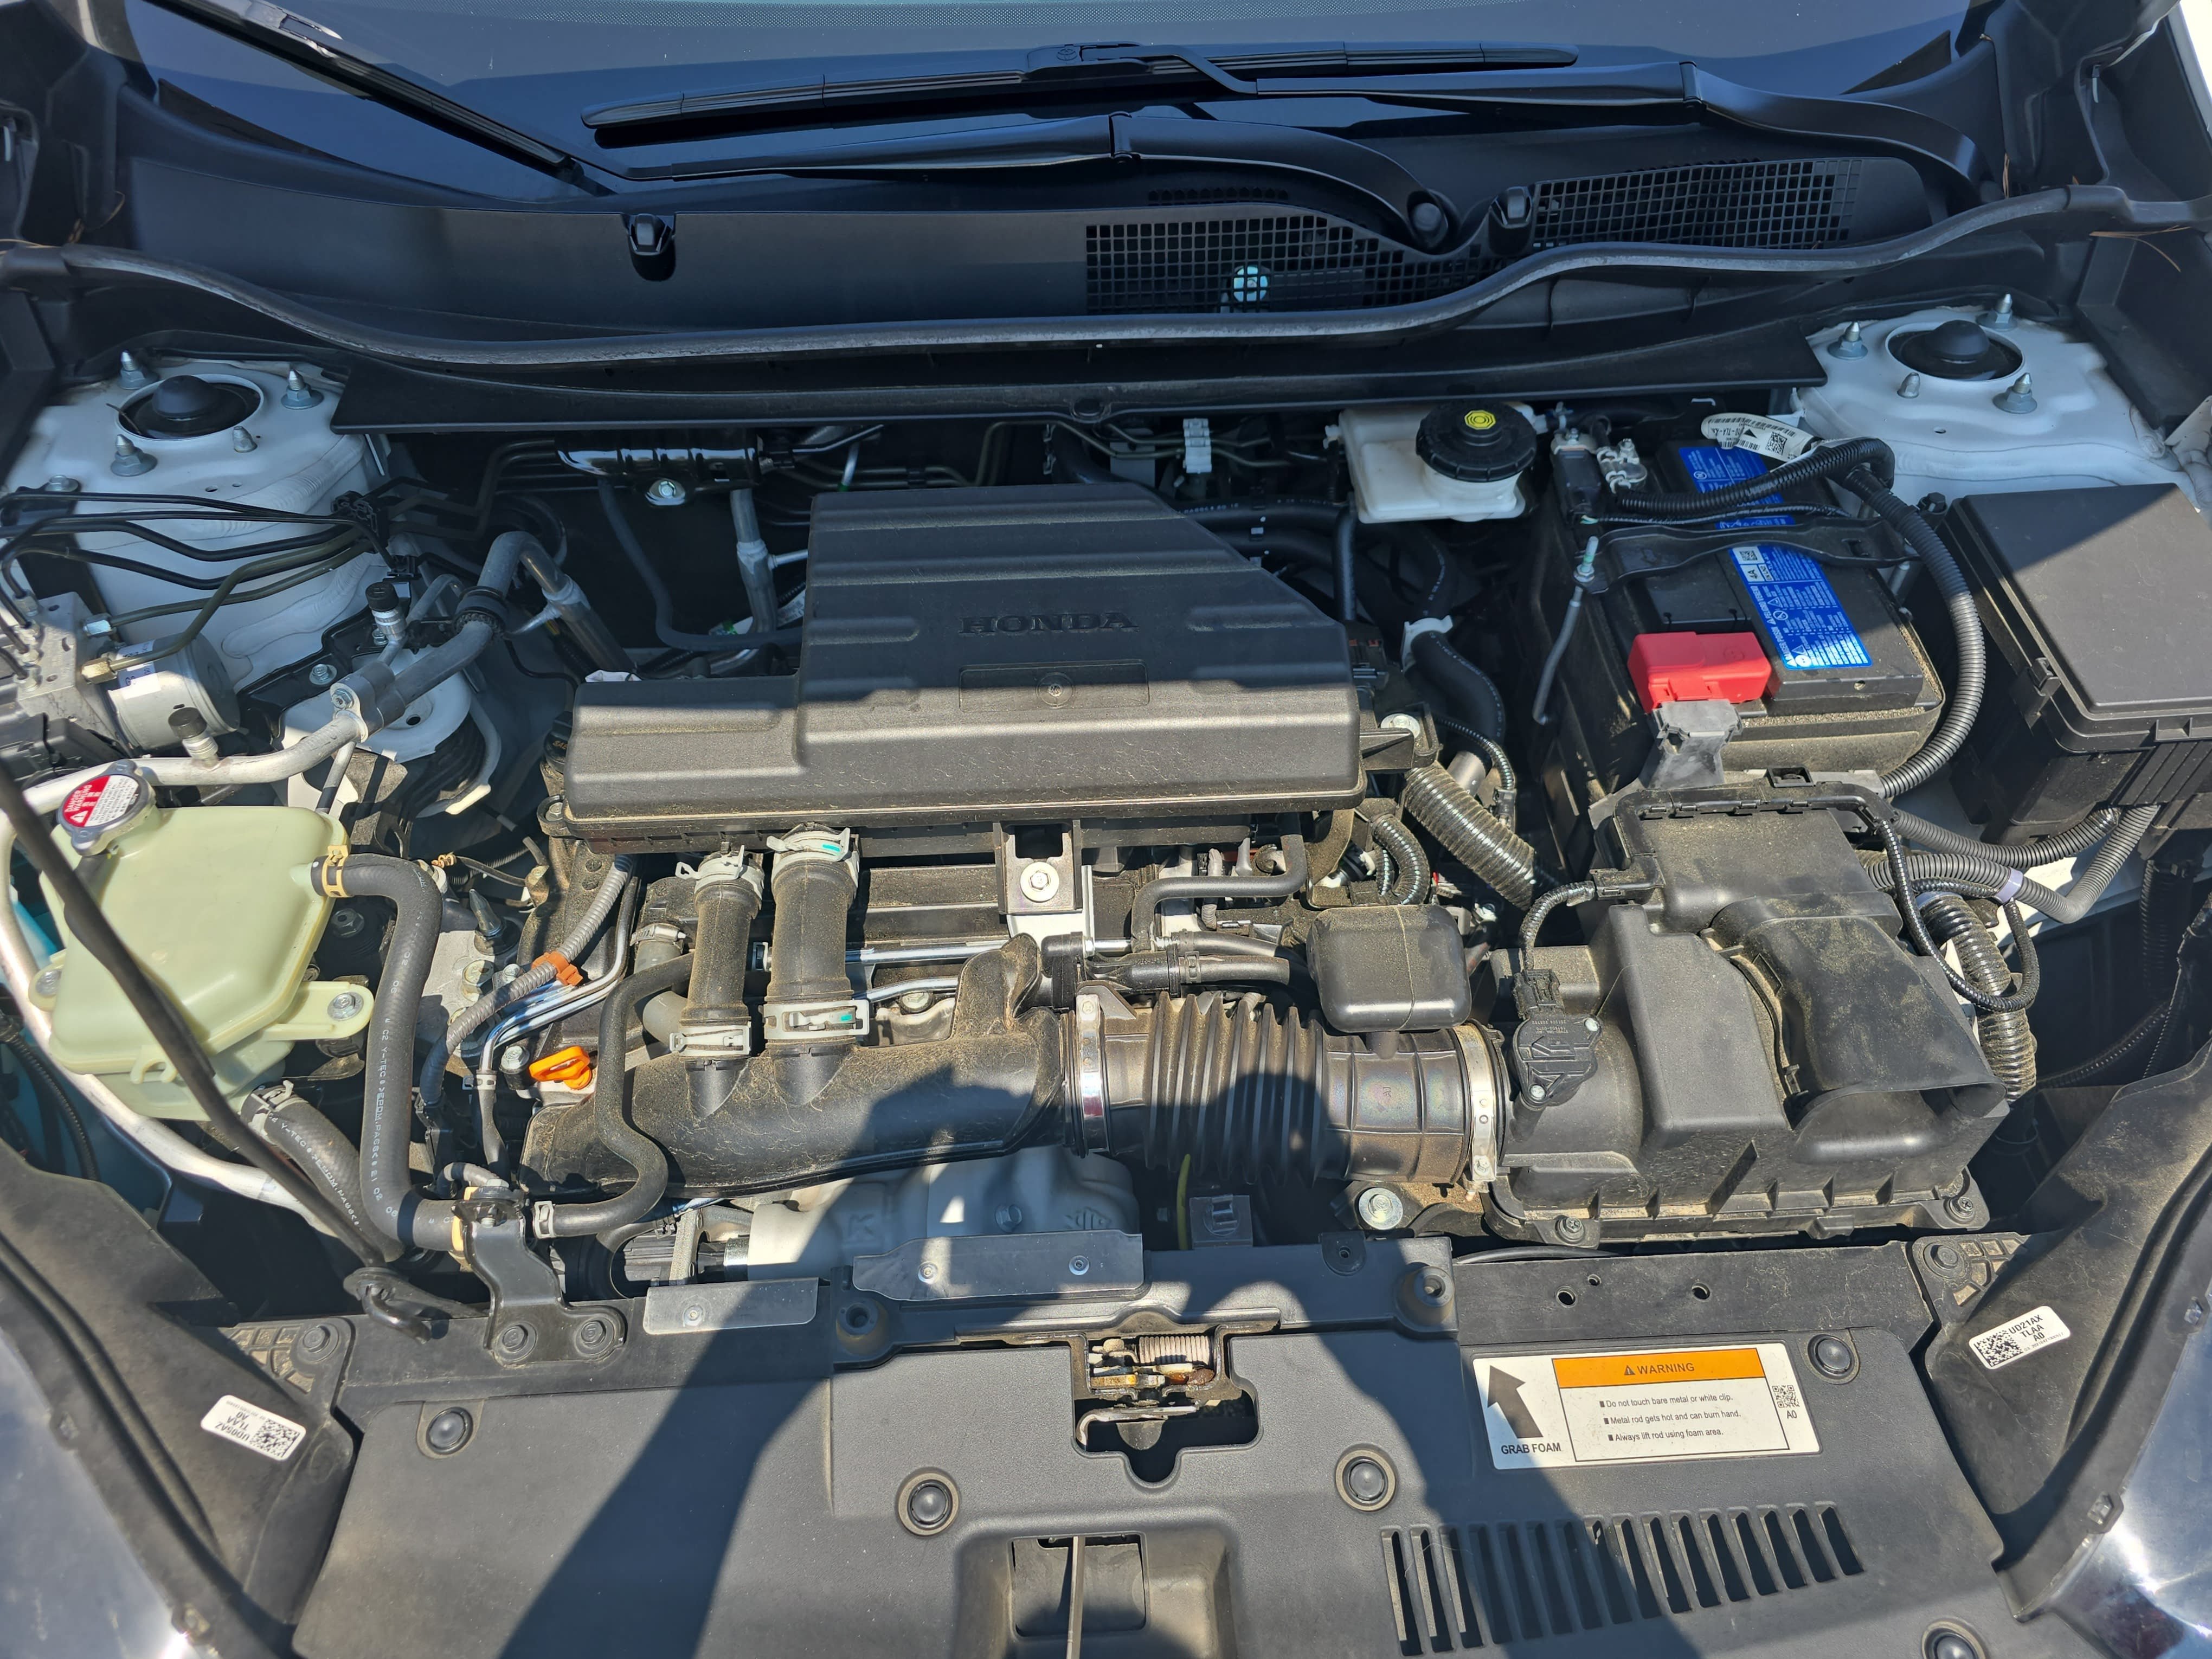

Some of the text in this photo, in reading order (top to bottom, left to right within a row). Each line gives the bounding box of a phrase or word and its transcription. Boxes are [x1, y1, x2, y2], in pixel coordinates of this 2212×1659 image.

[1747, 569, 1758, 579] 4A
[958, 612, 1139, 633] HONDA
[382, 1030, 389, 1041] C2
[379, 1046, 388, 1077] Y-TEC
[281, 1123, 307, 1147] Y-TEC
[2008, 1315, 2043, 1334] UD21AX
[2020, 1324, 2044, 1338] TLAA
[2033, 1332, 2045, 1341] A0
[1637, 1362, 1695, 1375] WARNING
[1618, 1399, 1629, 1407] not
[1631, 1398, 1650, 1406] touch
[1652, 1397, 1668, 1405] bare
[1699, 1393, 1718, 1401] white
[1719, 1393, 1733, 1402] clip.
[235, 1411, 250, 1420] A0
[1611, 1416, 1630, 1425] Metal
[1632, 1416, 1643, 1424] rod
[1645, 1414, 1660, 1424] gets
[1662, 1413, 1673, 1422] hot
[1675, 1412, 1688, 1420] and
[1704, 1411, 1720, 1419] burn
[1721, 1410, 1741, 1418] hand.
[227, 1416, 249, 1431] TLAA
[215, 1422, 250, 1441] UD05AZ
[1615, 1428, 1724, 1442] Always lift rod using foam area.
[1501, 1442, 1561, 1454] GRAB FOAM
